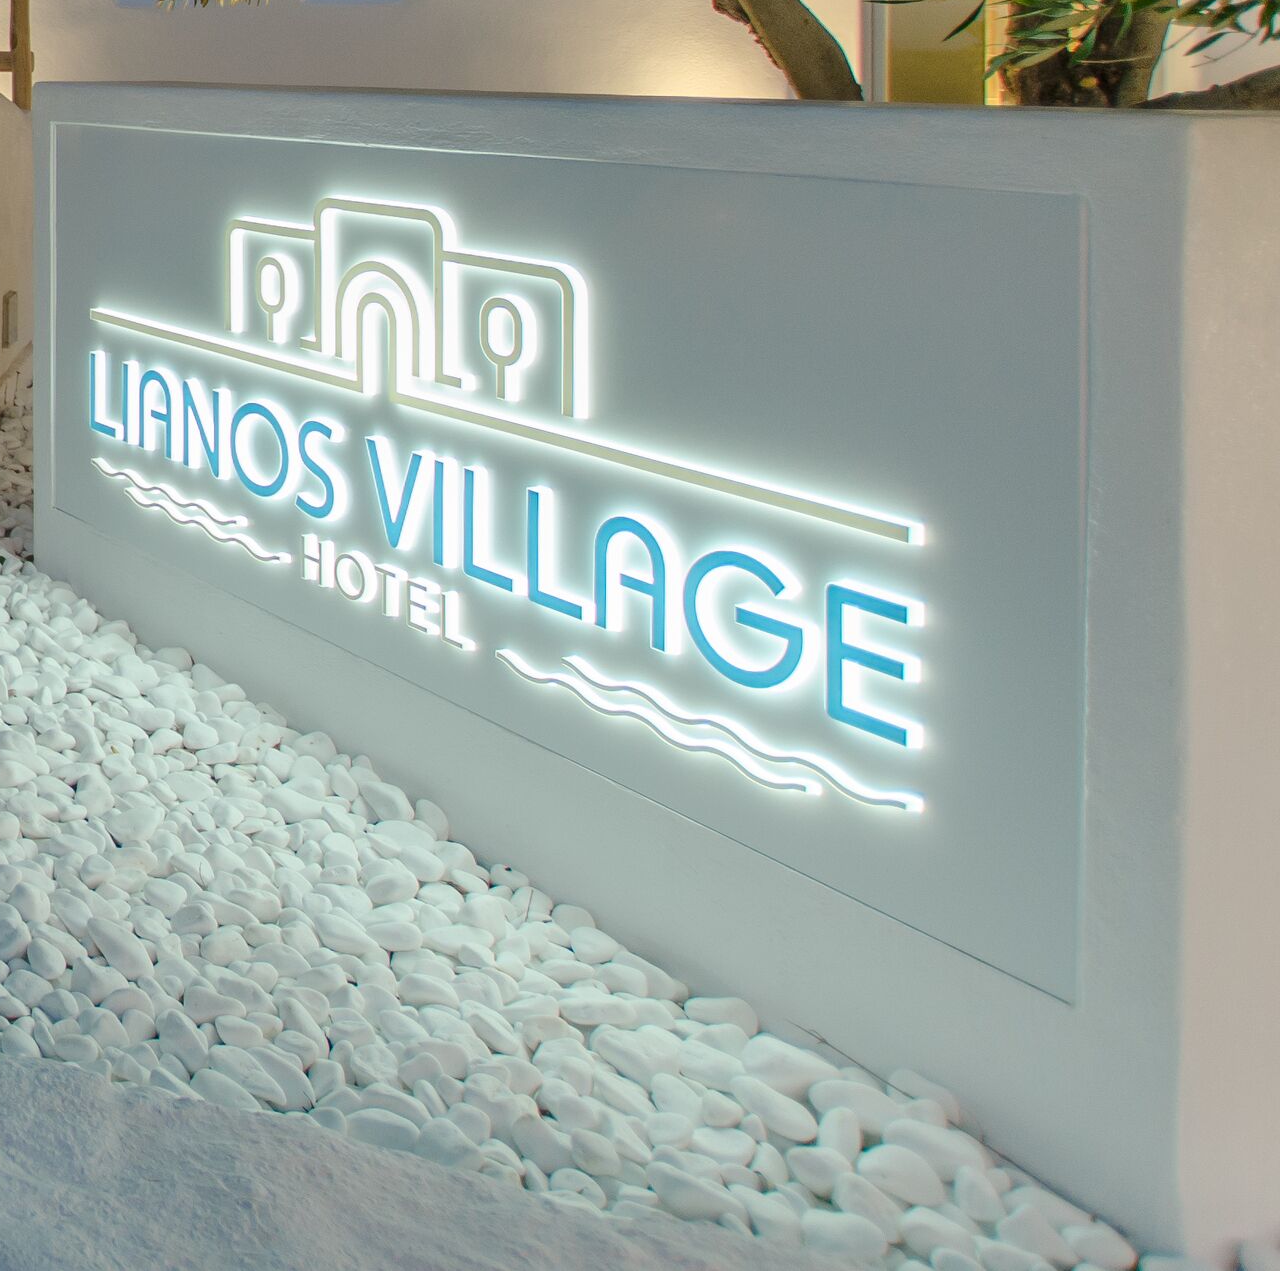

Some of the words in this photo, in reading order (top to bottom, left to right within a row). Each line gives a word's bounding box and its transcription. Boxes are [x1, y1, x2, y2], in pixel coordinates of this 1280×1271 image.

[90, 350, 345, 521] LIANOS
[365, 435, 925, 749] VILLAGE
[301, 533, 476, 652] HOTEL
